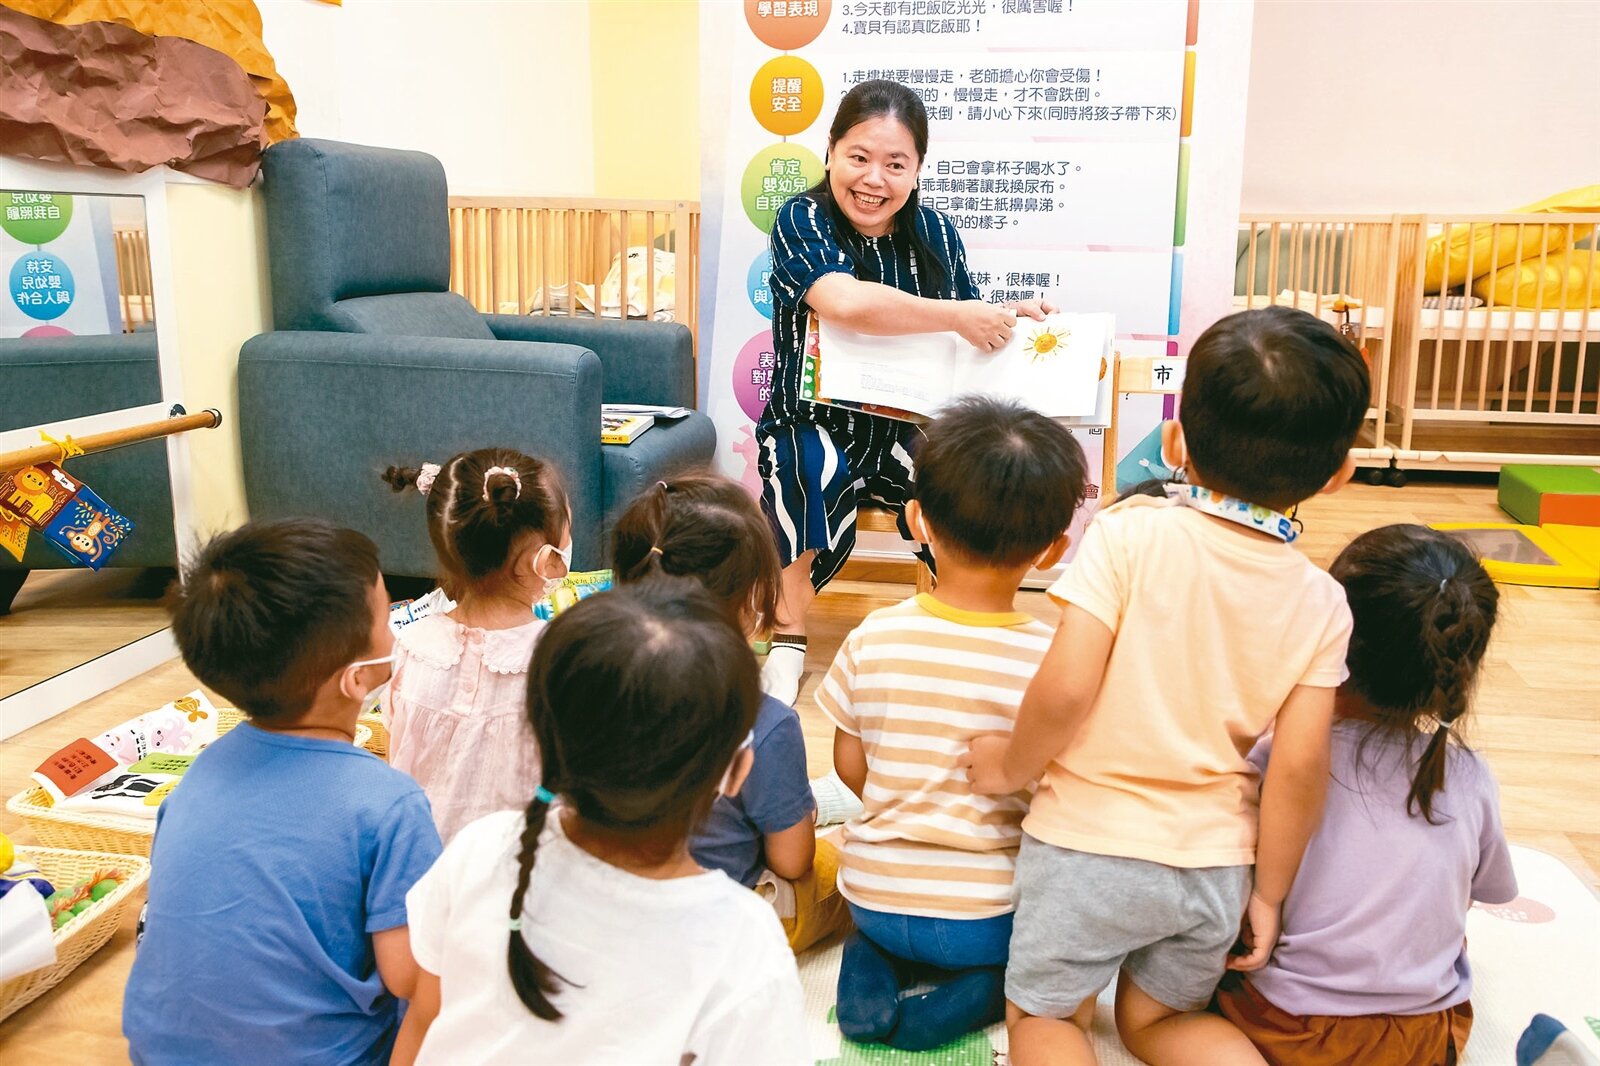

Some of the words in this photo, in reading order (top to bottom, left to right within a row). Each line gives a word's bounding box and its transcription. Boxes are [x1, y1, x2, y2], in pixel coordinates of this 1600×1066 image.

[757, 0, 819, 17] 學習表現
[771, 77, 802, 94] 提醒
[771, 96, 802, 112] 安全
[770, 159, 801, 175] 肯定
[762, 177, 807, 193] 嬰幼兒
[918, 178, 1065, 194] 乖乖躺著讓我換尿布。
[945, 214, 1019, 229] 奶的樣子。
[753, 289, 773, 304] 與
[759, 352, 775, 368] 表
[1154, 365, 1173, 385] 市
[759, 386, 771, 402] 的
